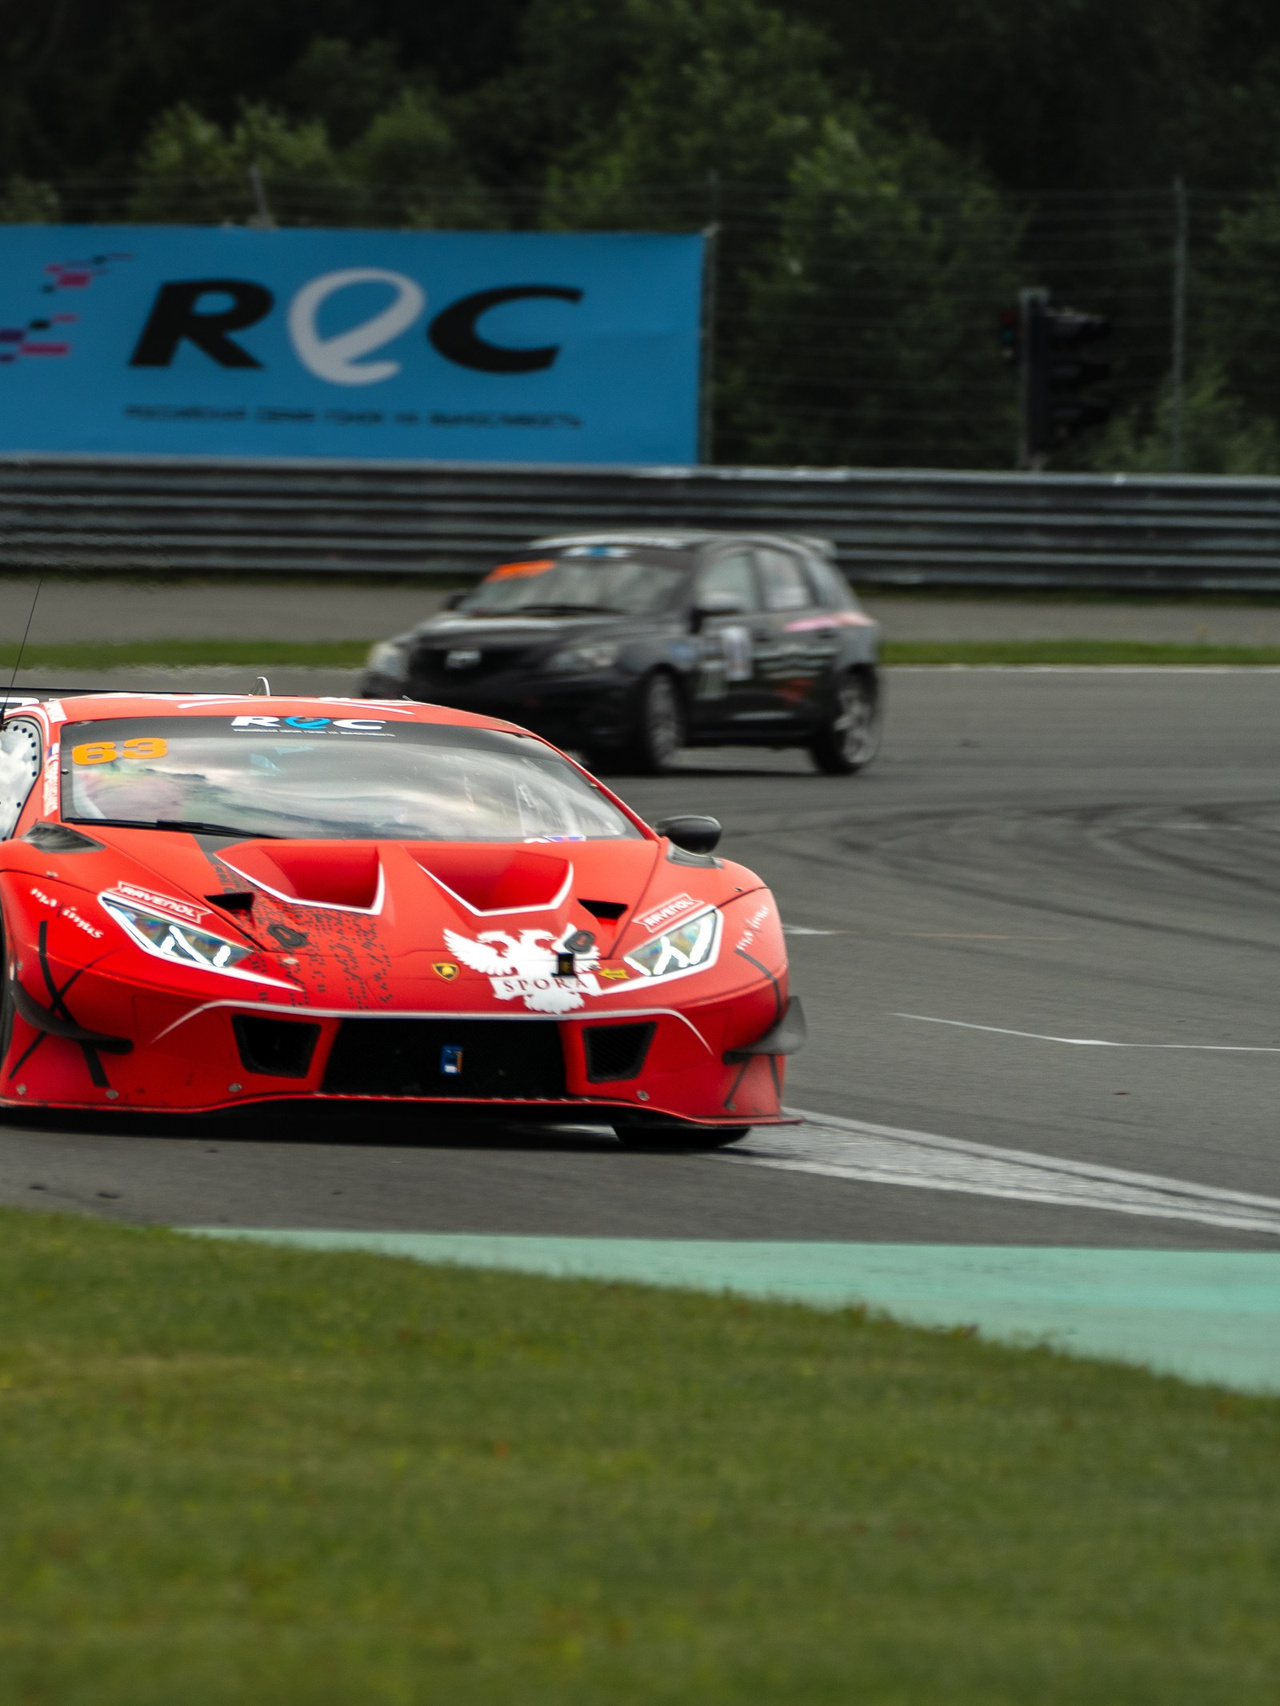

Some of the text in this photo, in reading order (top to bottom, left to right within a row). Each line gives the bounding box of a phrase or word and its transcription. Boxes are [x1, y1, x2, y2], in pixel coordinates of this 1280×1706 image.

[72, 737, 168, 766] 63
[120, 885, 201, 918] RAVENOL
[503, 978, 589, 992] SPORA
